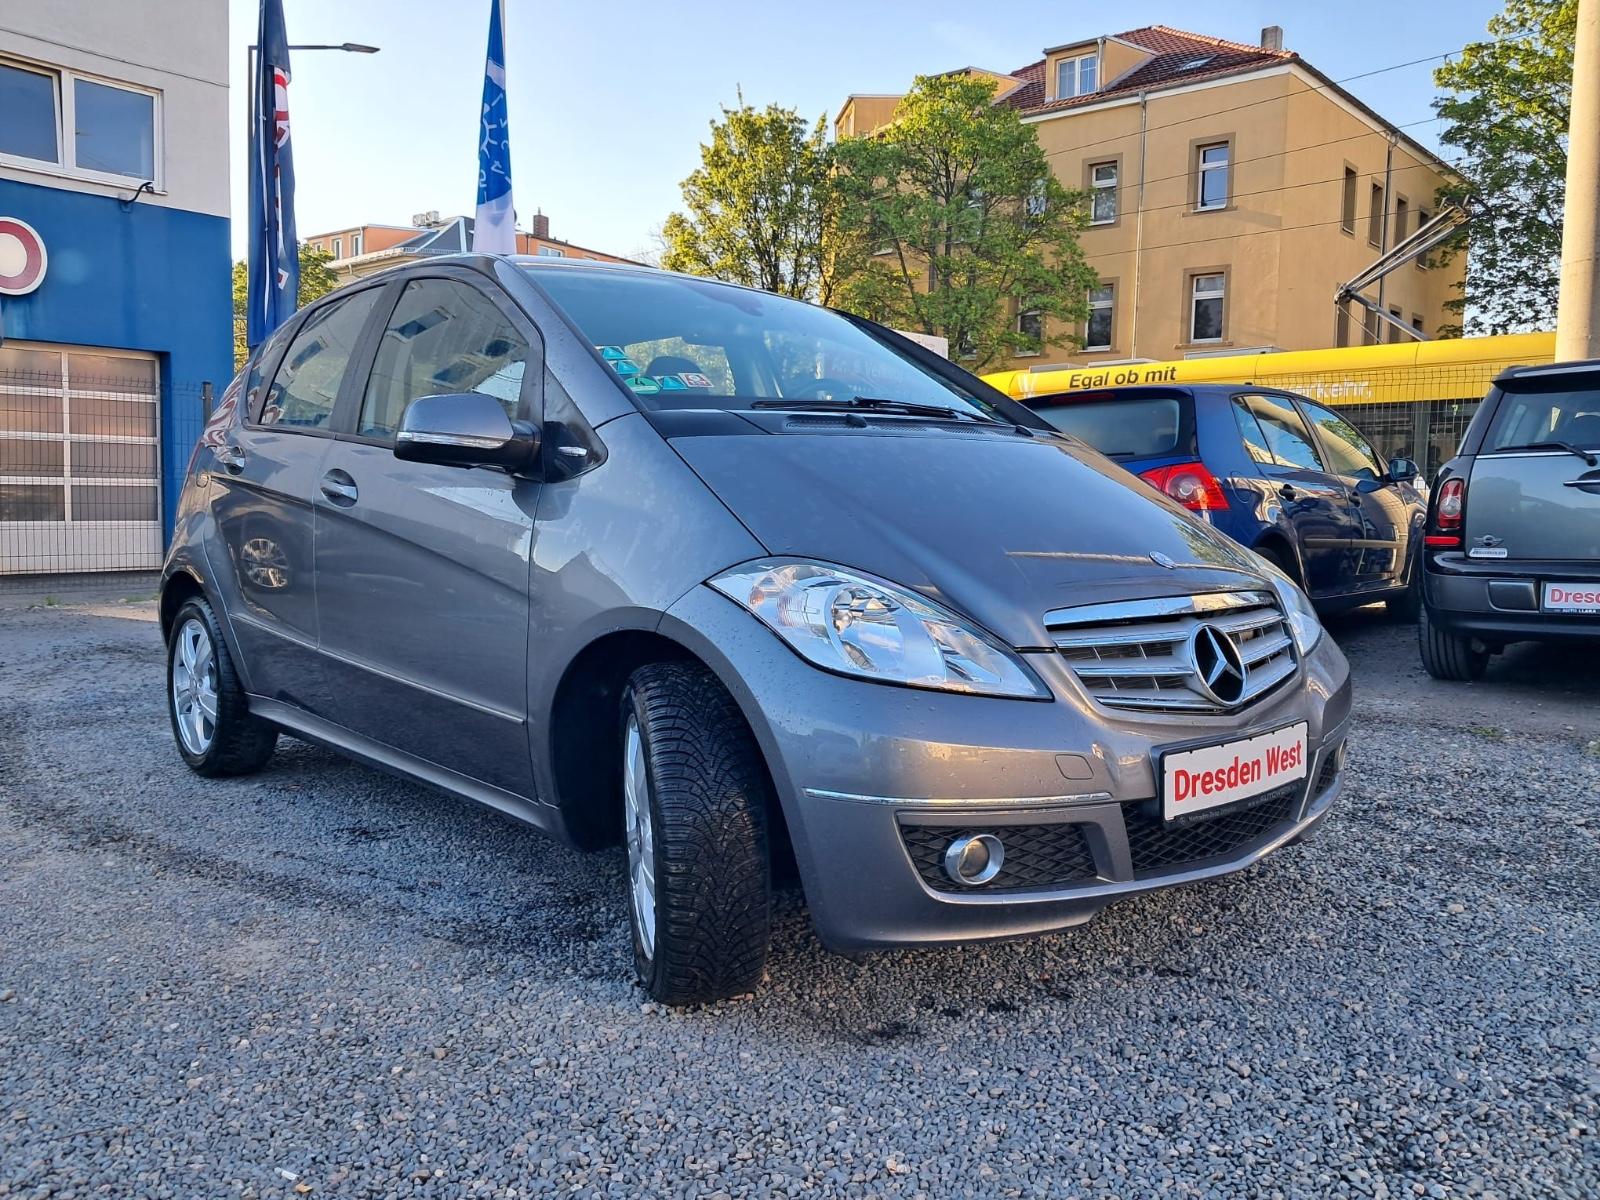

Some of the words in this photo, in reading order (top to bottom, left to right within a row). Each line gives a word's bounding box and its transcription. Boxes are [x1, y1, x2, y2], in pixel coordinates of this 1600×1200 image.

[1069, 371, 1110, 389] Egal
[1114, 369, 1140, 385] ob
[1144, 366, 1177, 382] mit
[1174, 755, 1261, 802] Dresden
[1265, 739, 1302, 777] West
